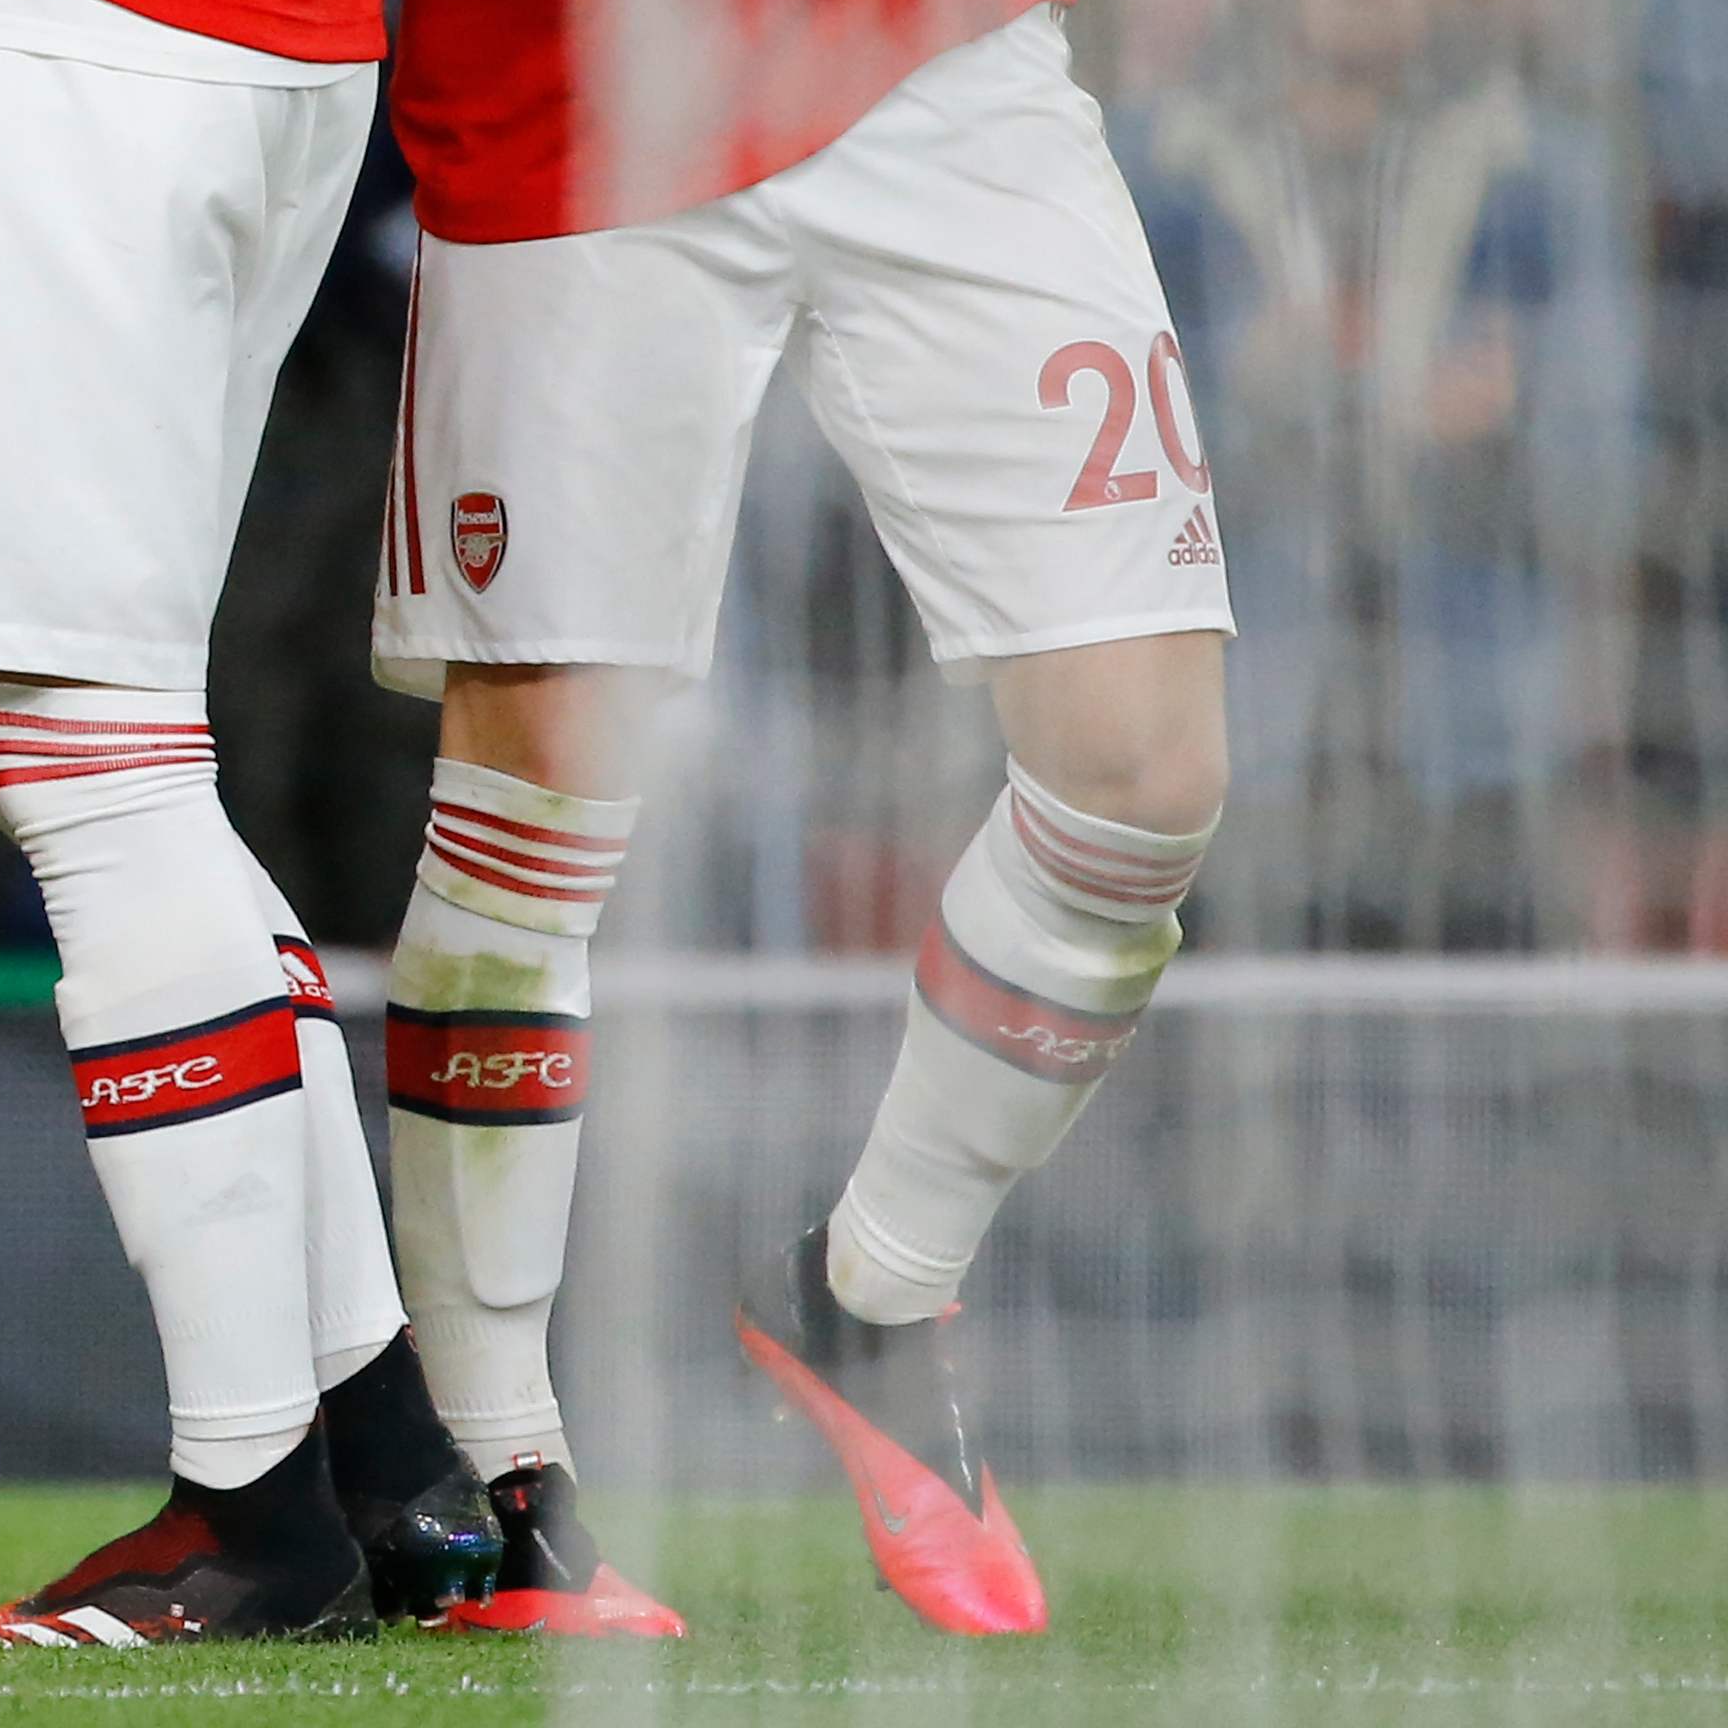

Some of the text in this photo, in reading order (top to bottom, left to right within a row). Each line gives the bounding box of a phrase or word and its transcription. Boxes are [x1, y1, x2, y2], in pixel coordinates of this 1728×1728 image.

[1036, 330, 1210, 514] 20
[81, 1056, 224, 1109] AFC
[430, 1050, 574, 1089] AFC
